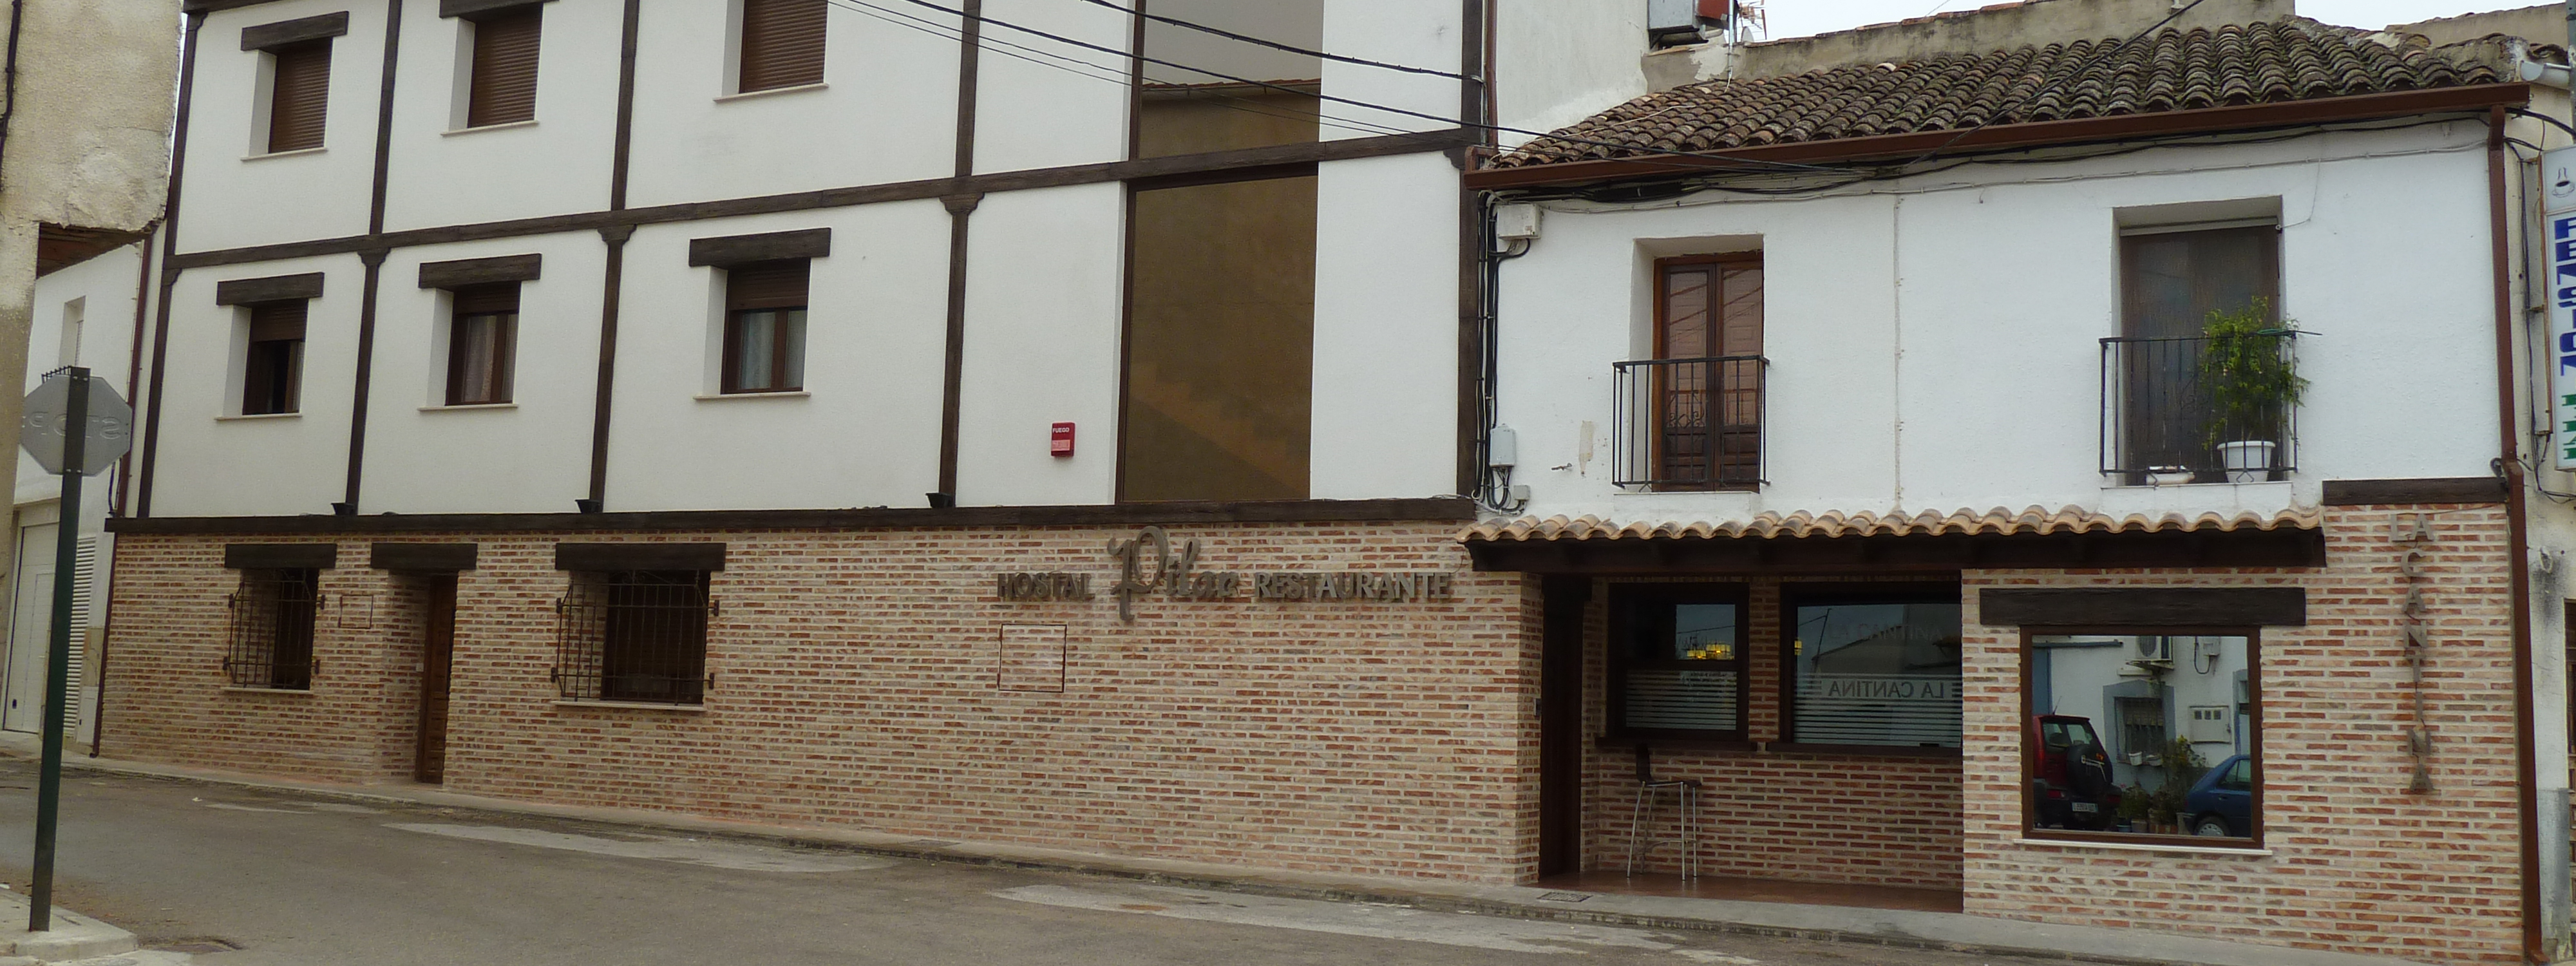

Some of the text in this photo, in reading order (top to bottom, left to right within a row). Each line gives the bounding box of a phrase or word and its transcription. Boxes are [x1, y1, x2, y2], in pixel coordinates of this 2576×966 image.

[997, 525, 1453, 623] HOSTAL Pilar RESTAURANTE
[2391, 513, 2434, 542] LA
[2400, 548, 2436, 793] CANTINA
